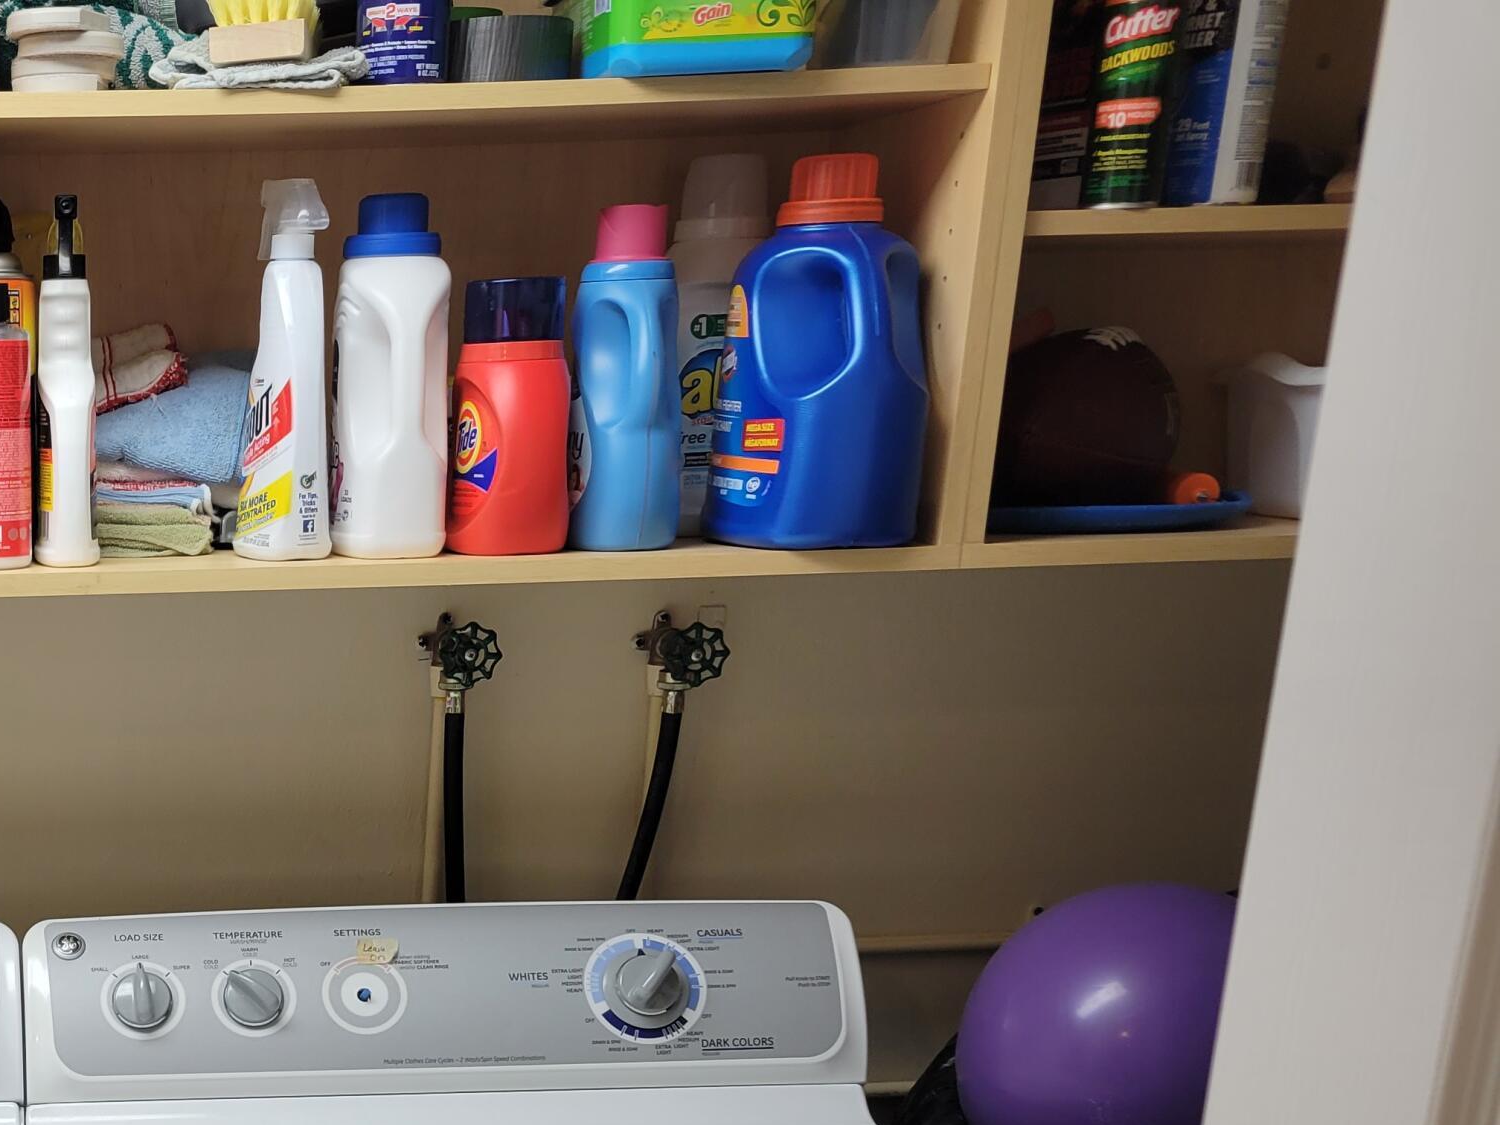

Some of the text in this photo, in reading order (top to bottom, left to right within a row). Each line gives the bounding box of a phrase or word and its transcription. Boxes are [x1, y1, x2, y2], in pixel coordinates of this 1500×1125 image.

[694, 2, 731, 25] Gain
[1105, 6, 1180, 46] Cutter
[1101, 40, 1176, 72] BACKWOODS
[1108, 112, 1127, 128] 10
[693, 317, 707, 336] #1
[457, 420, 478, 454] Tide
[681, 432, 706, 445] ree
[114, 933, 164, 942] LOAD SIZE
[212, 930, 283, 940] TEMPERATURE
[333, 928, 381, 937] SETTINGS
[696, 928, 743, 937] CASUALS
[508, 972, 549, 981] WHITES
[701, 1037, 774, 1048] DARK COLORS
